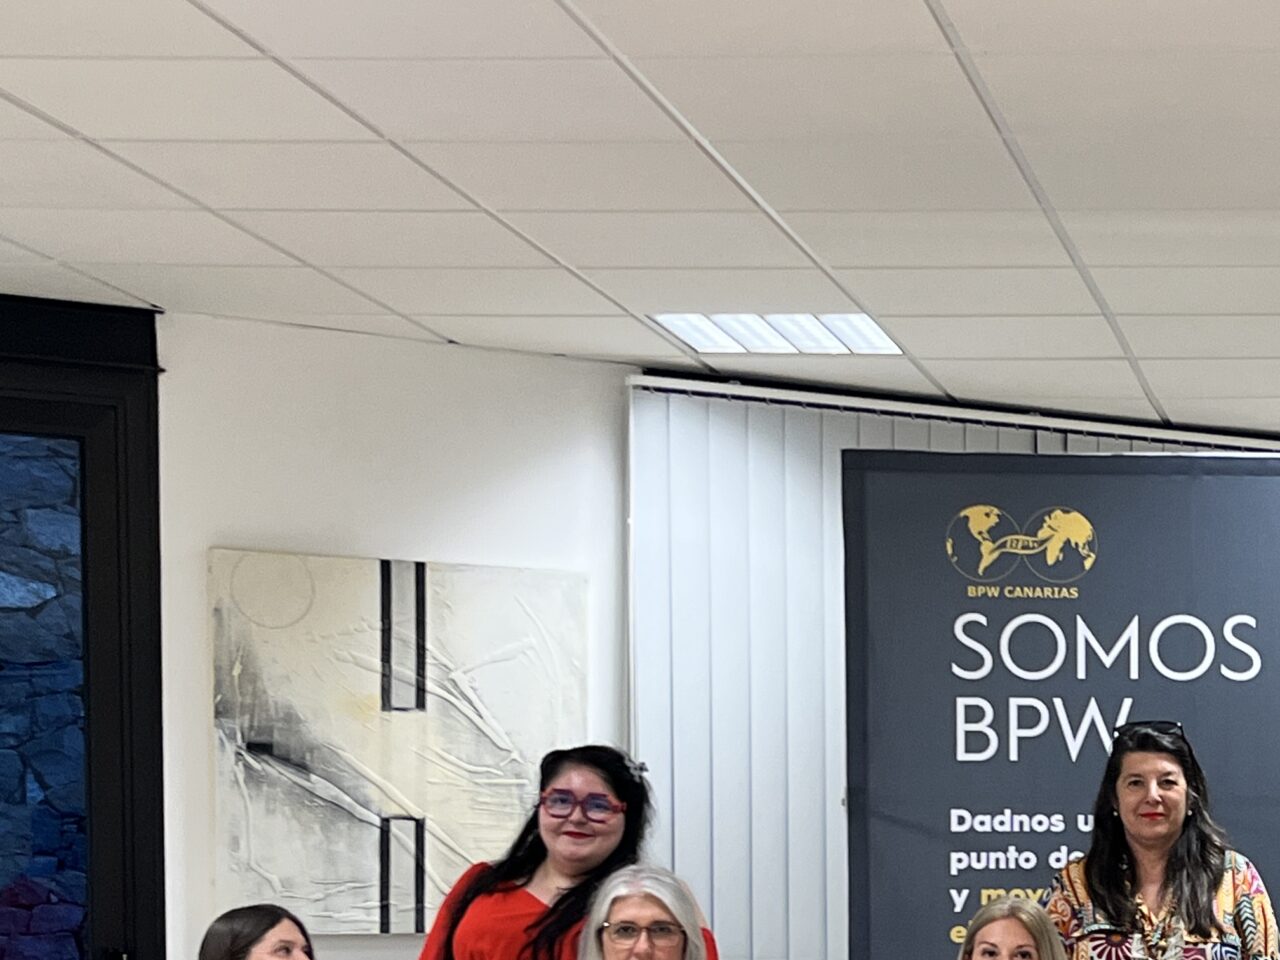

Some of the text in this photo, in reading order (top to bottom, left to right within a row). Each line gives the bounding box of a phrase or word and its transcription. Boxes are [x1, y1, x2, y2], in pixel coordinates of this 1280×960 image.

[967, 586, 1079, 599] BPW CANARIAS
[951, 612, 1262, 682] SOMOS
[955, 697, 1133, 763] BPW
[950, 808, 1066, 833] Dadnos
[950, 845, 1038, 876] punto
[949, 888, 970, 913] y
